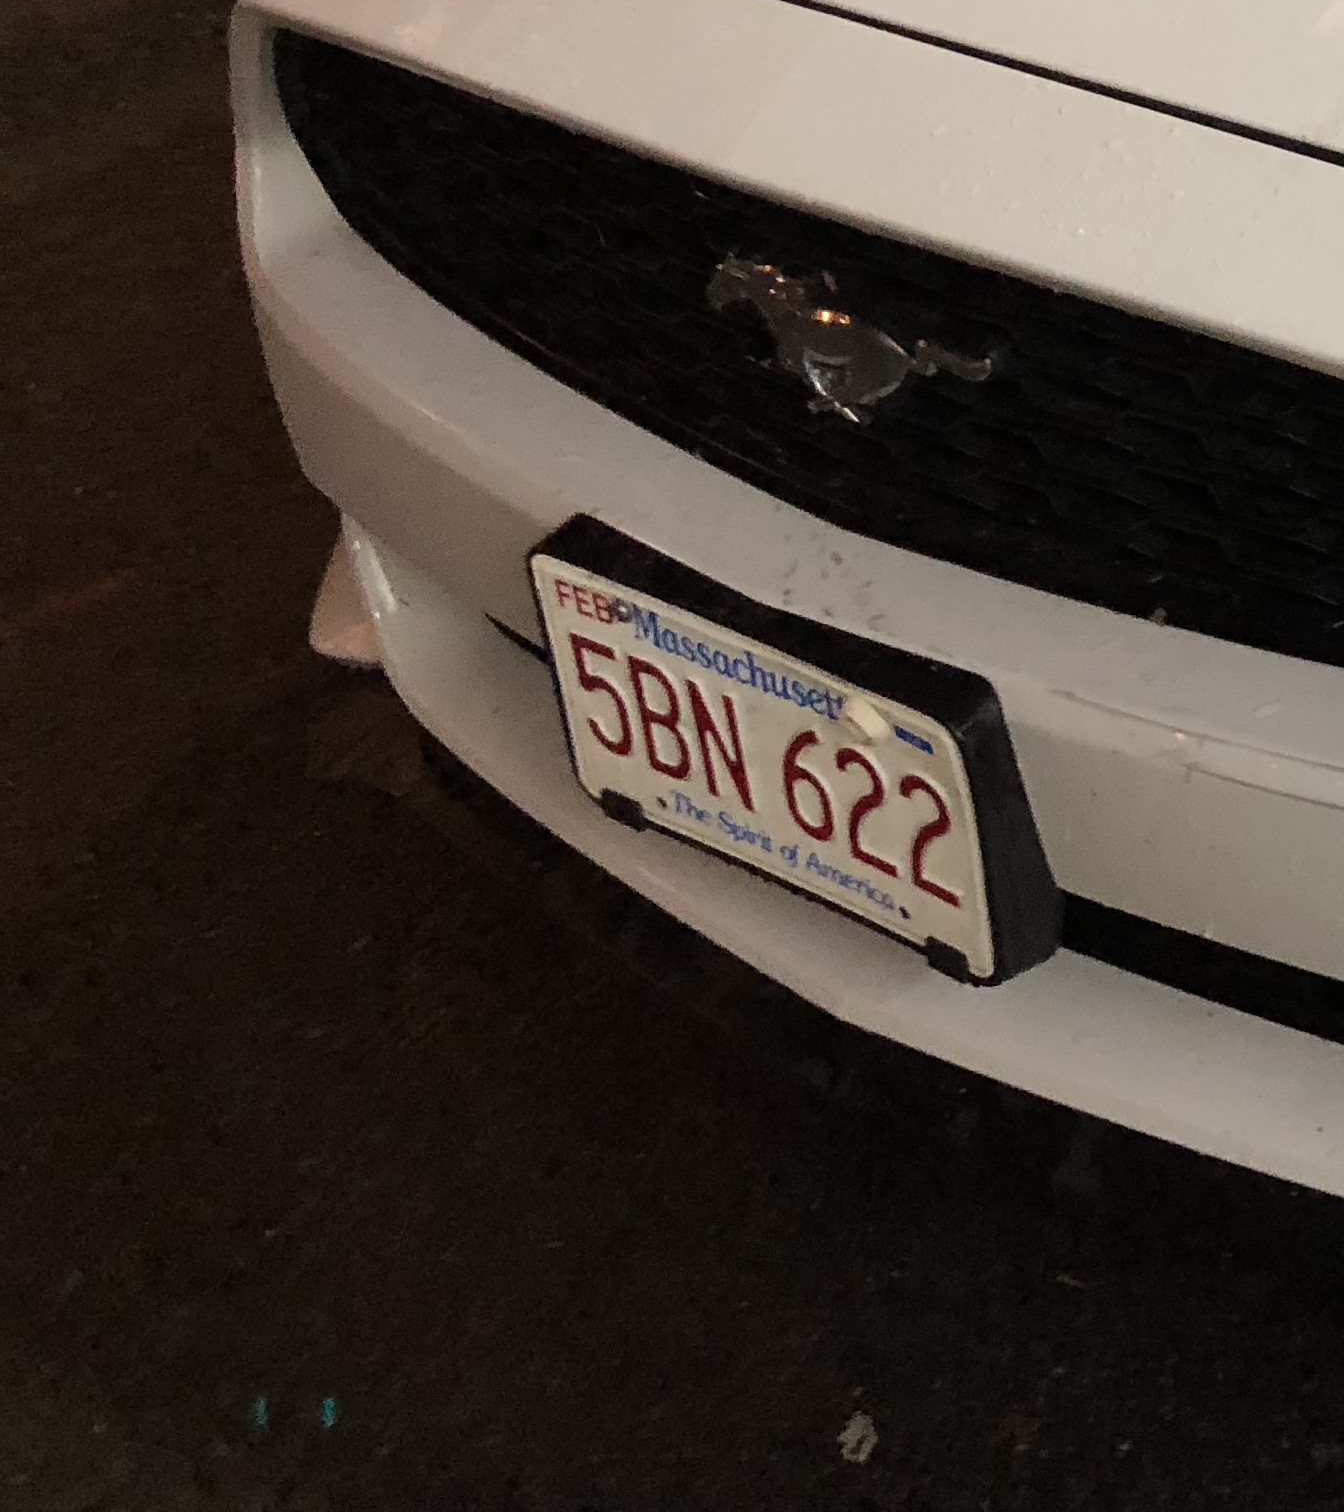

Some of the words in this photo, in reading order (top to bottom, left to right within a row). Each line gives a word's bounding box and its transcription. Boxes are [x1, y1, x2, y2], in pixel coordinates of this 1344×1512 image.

[554, 578, 617, 625] FEB
[568, 632, 757, 813] 5BN
[781, 728, 961, 909] 622
[673, 790, 712, 824] The
[717, 809, 773, 853] Spirit
[779, 844, 801, 868] of
[805, 851, 896, 911] America
